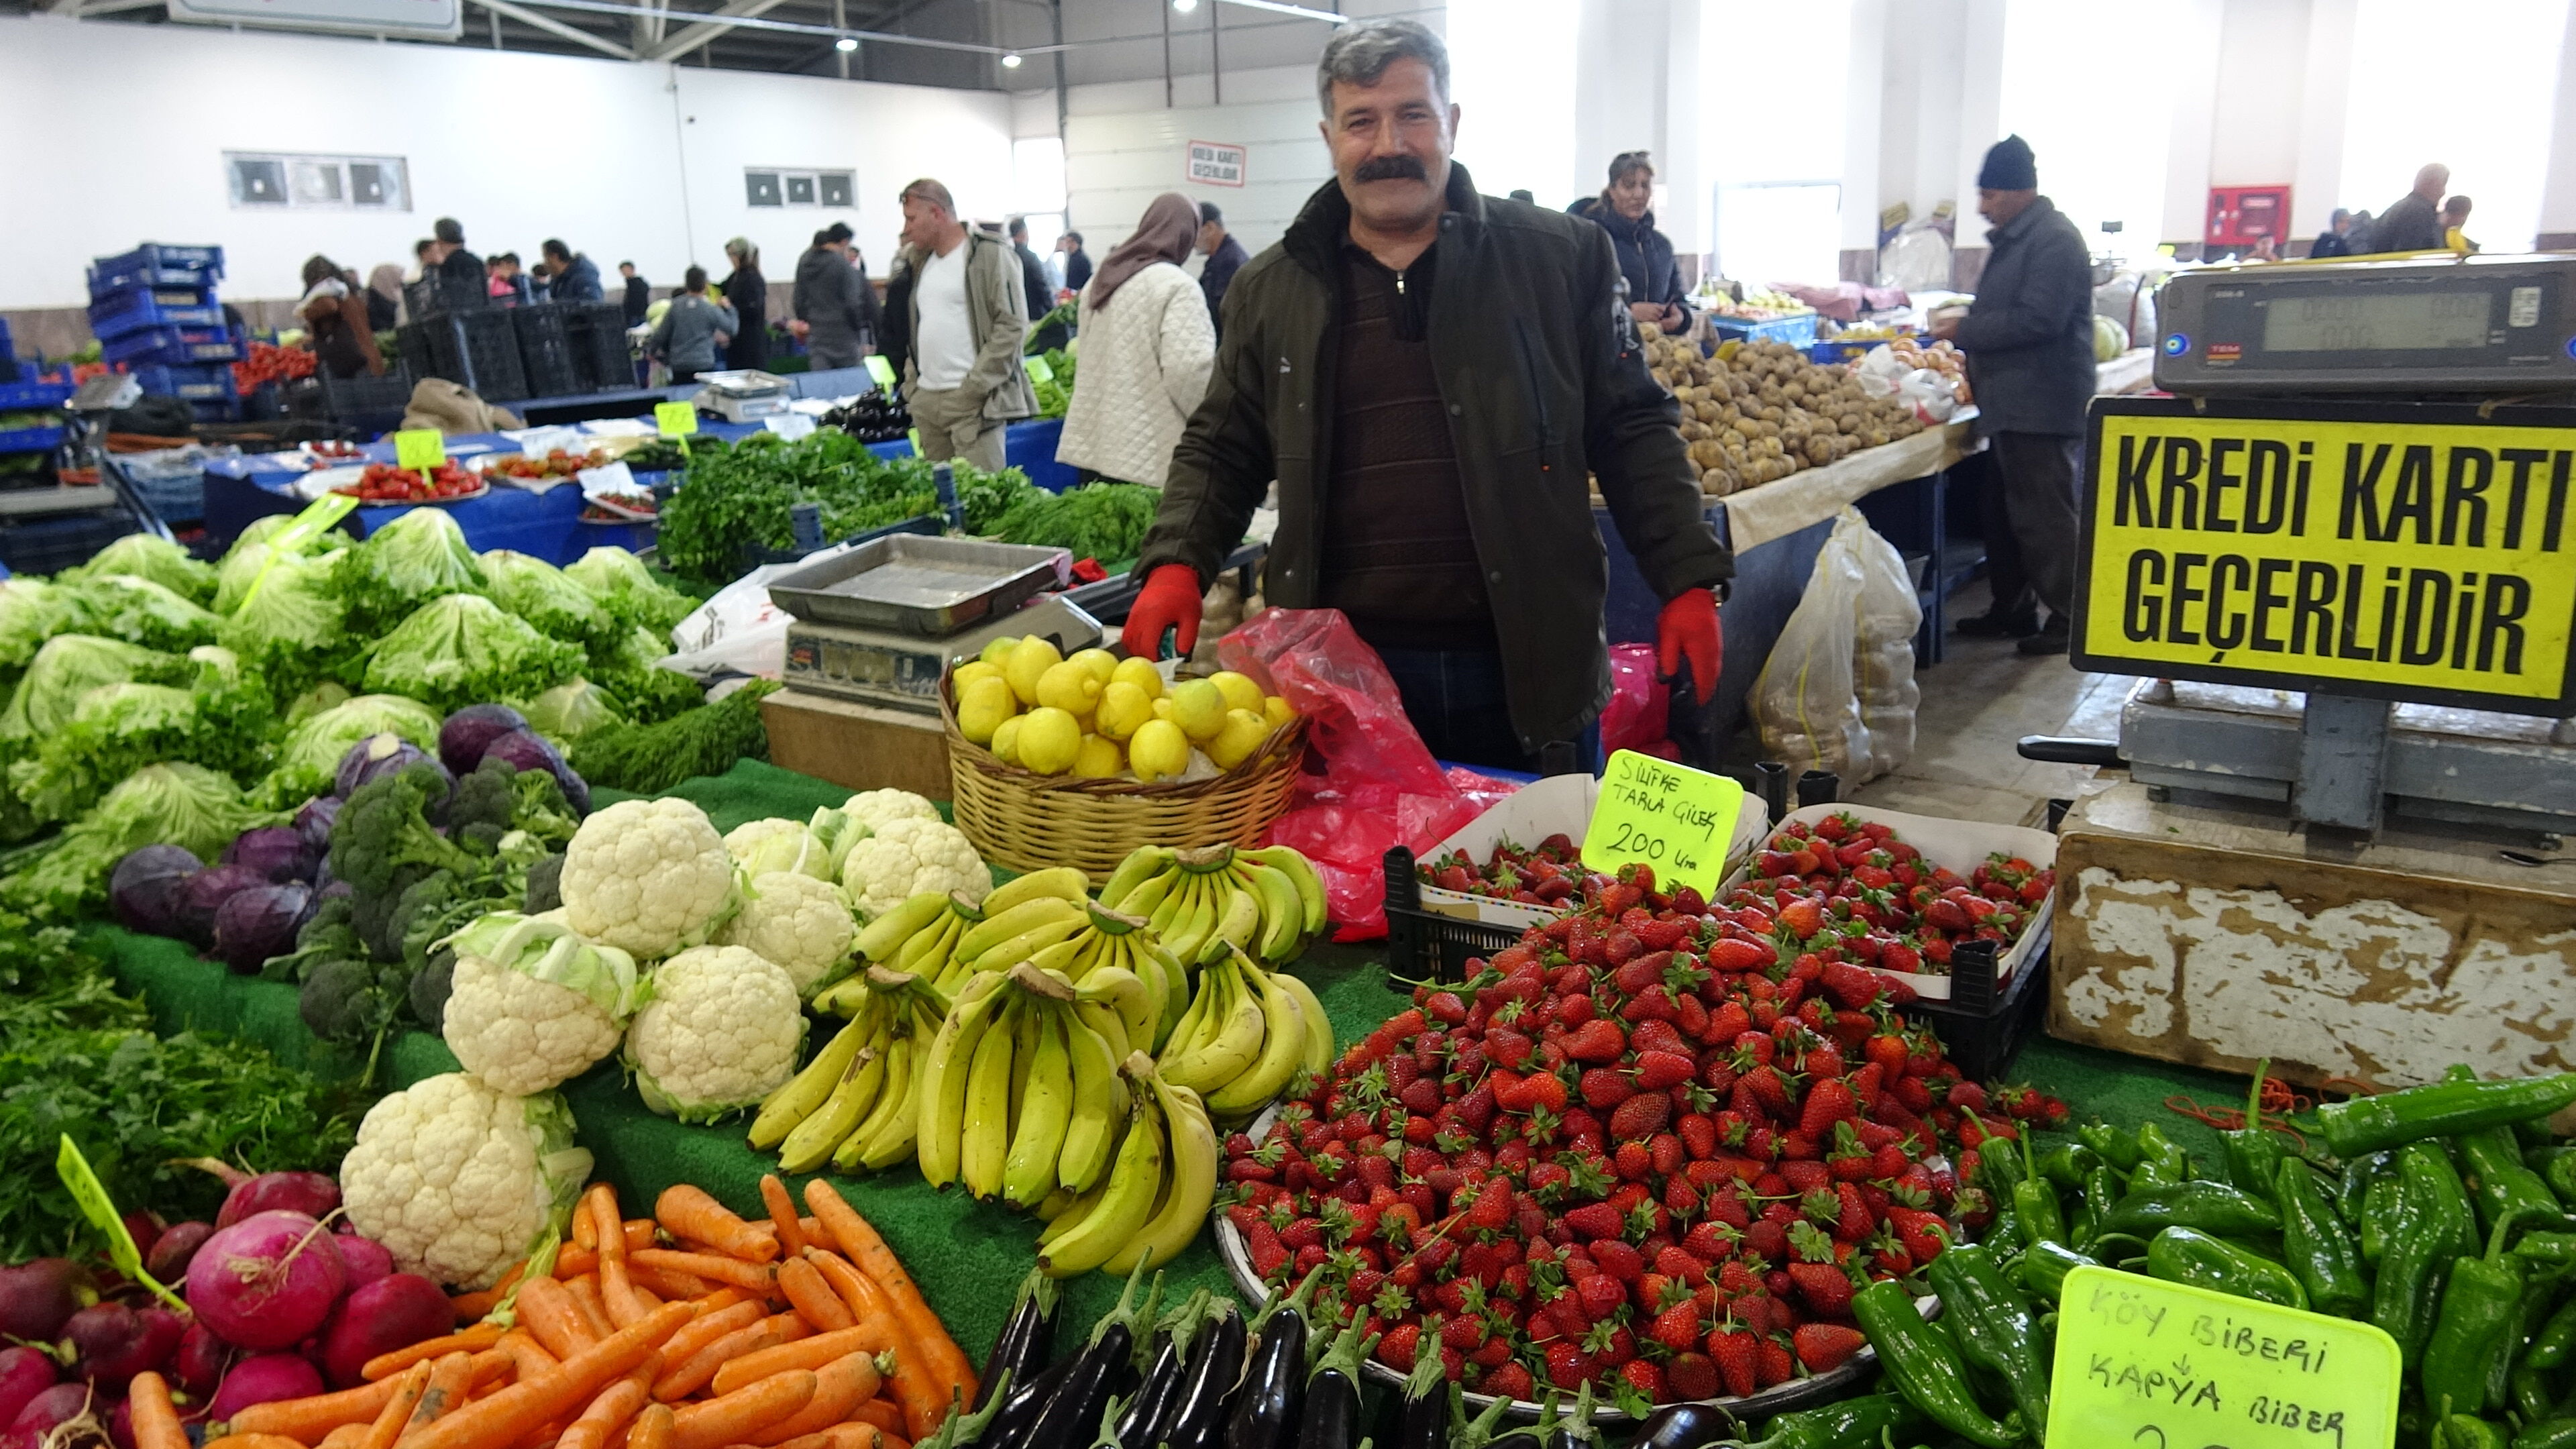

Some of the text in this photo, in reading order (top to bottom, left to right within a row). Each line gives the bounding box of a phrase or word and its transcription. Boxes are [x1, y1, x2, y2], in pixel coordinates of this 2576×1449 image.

[2337, 443, 2573, 552] KARTI
[1606, 823, 1664, 859] 200
[2090, 1284, 2167, 1337] KÖY
[2088, 1353, 2220, 1411] KAPYA
